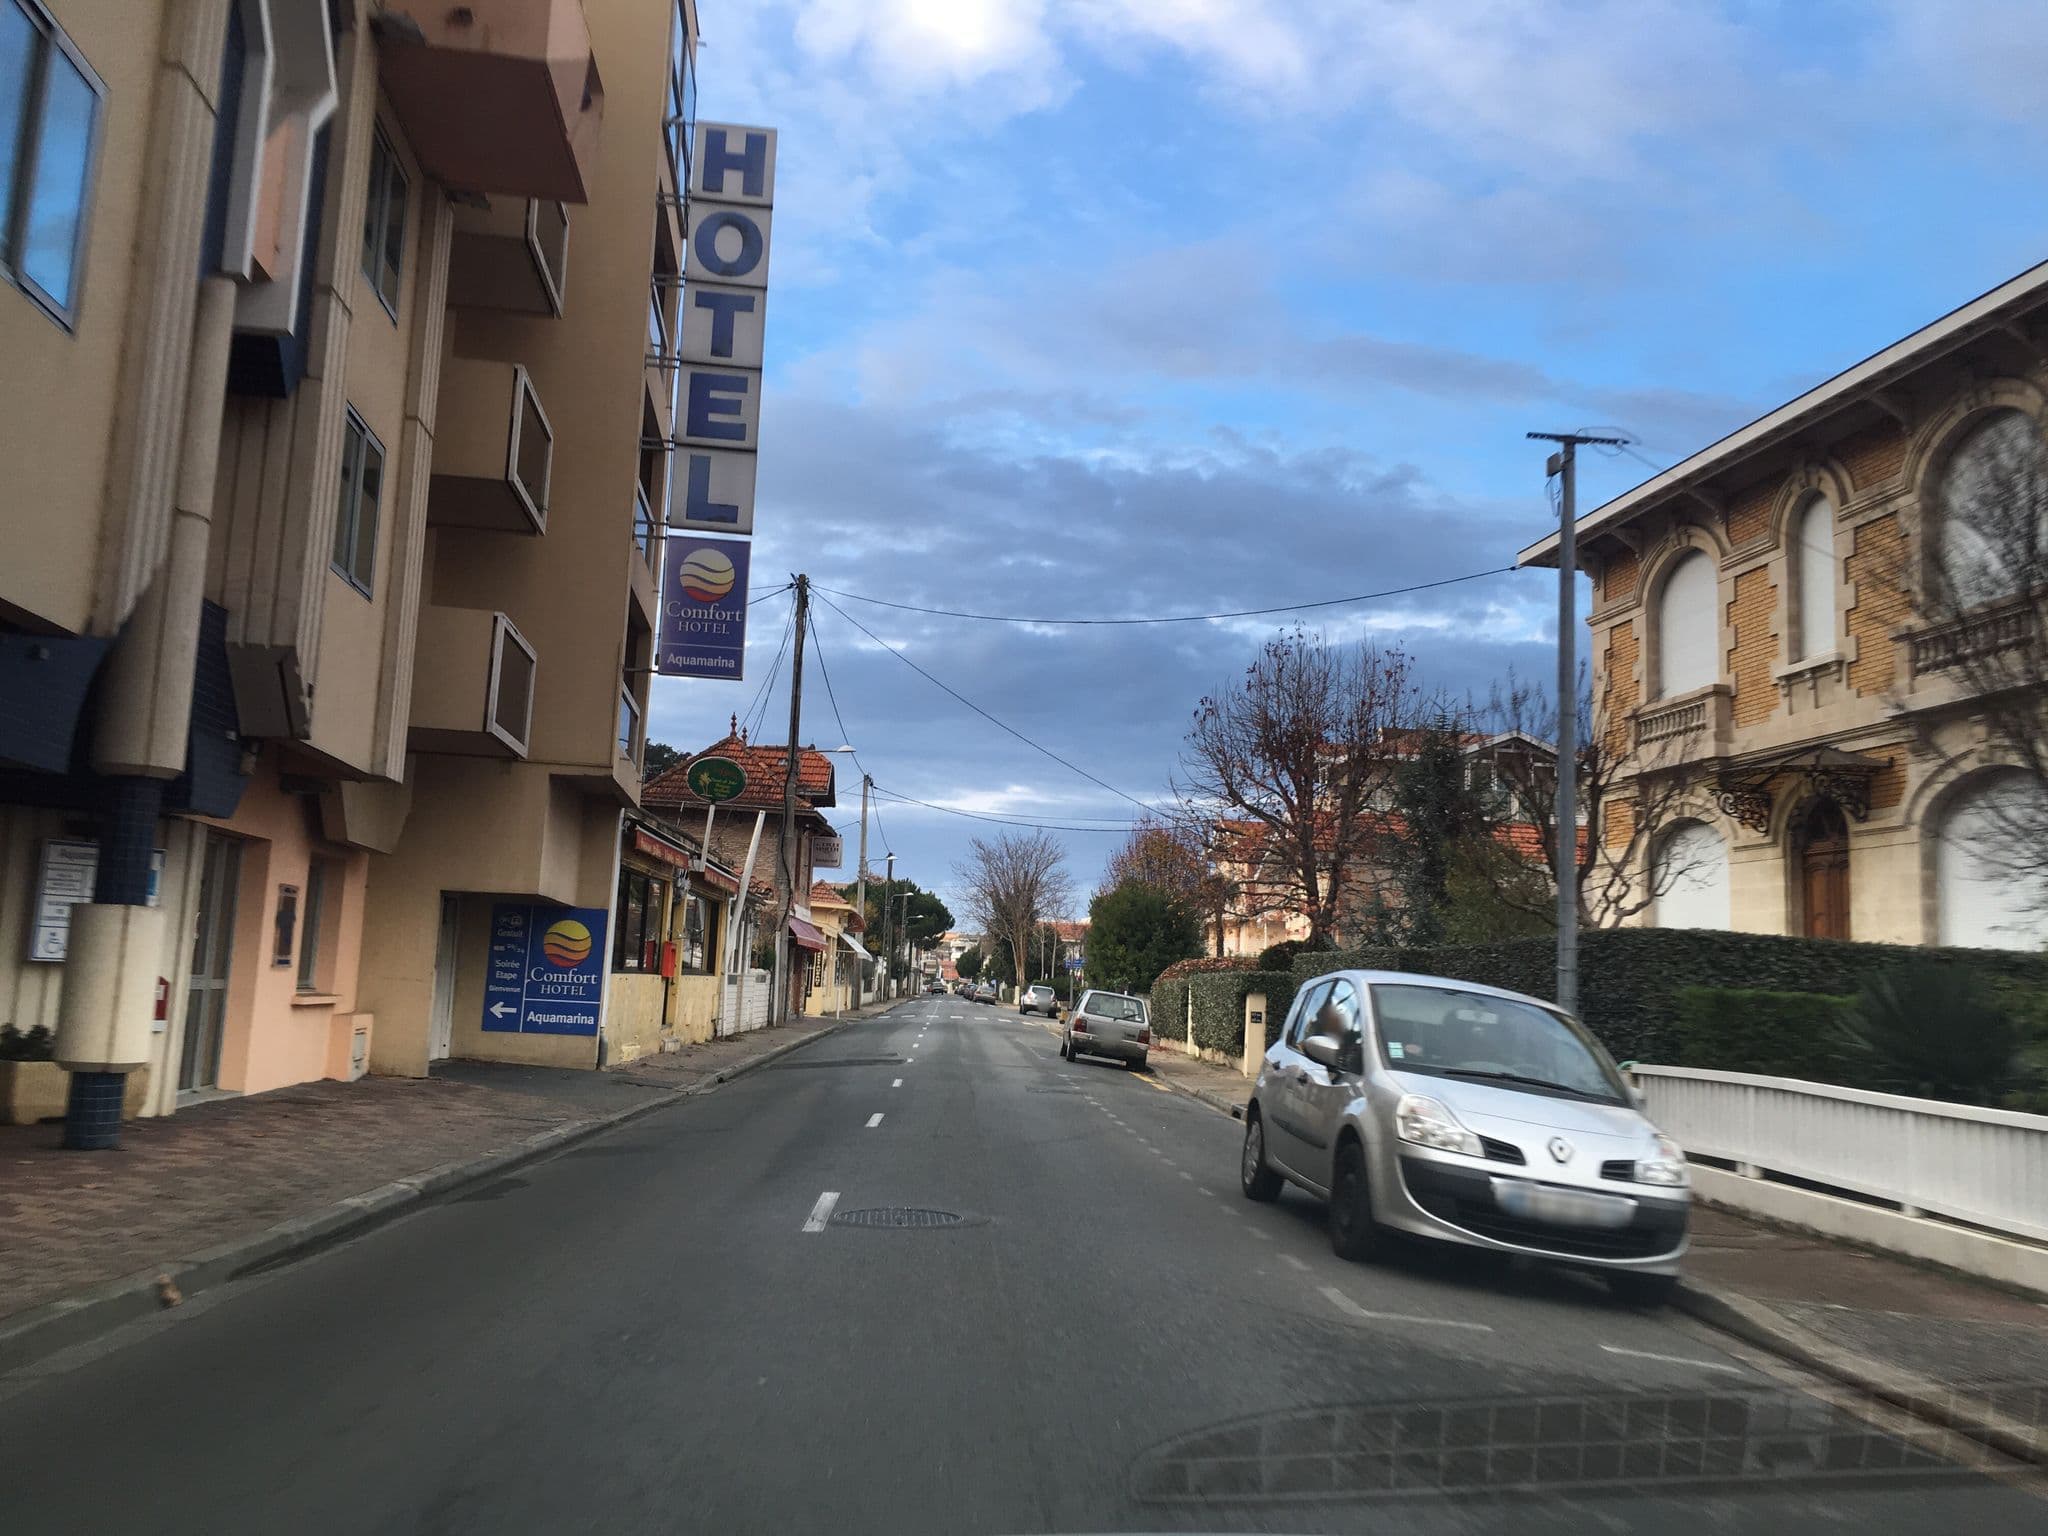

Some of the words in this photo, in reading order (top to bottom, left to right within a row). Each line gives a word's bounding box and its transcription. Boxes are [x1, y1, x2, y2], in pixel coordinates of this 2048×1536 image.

[686, 128, 766, 523] HOTEL
[666, 601, 744, 622] Comfort
[678, 621, 730, 635] HOTEL
[667, 653, 735, 668] Aquamarina
[495, 960, 521, 969] Soirée
[531, 967, 598, 985] Comfort
[541, 985, 586, 996] HOTEL
[527, 1011, 594, 1025] Aquamarina
